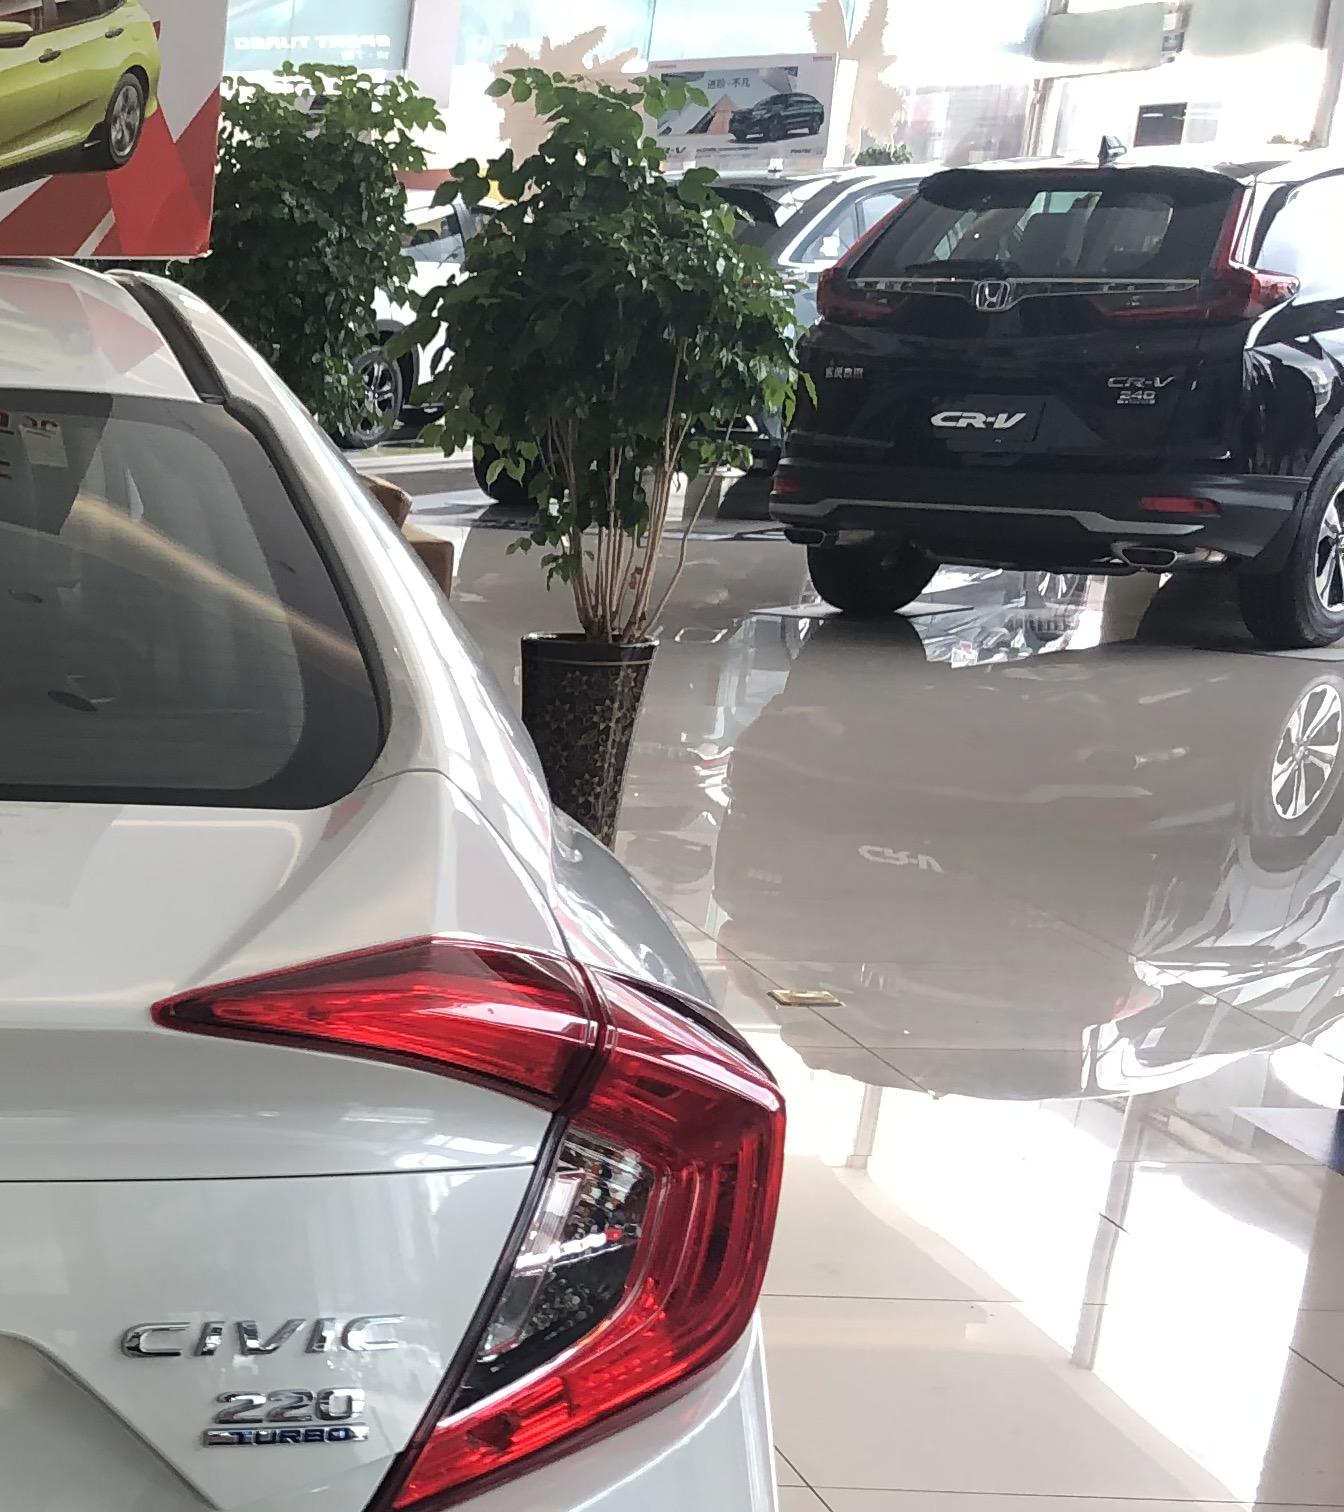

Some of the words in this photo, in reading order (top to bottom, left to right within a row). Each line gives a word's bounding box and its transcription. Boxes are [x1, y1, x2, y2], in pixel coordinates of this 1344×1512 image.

[1107, 376, 1175, 388] CR-V
[1119, 390, 1156, 400] 240
[930, 411, 1027, 429] CR-V
[120, 1314, 407, 1358] CIVIC
[215, 1387, 366, 1424] 220
[232, 1427, 352, 1445] TURBO
